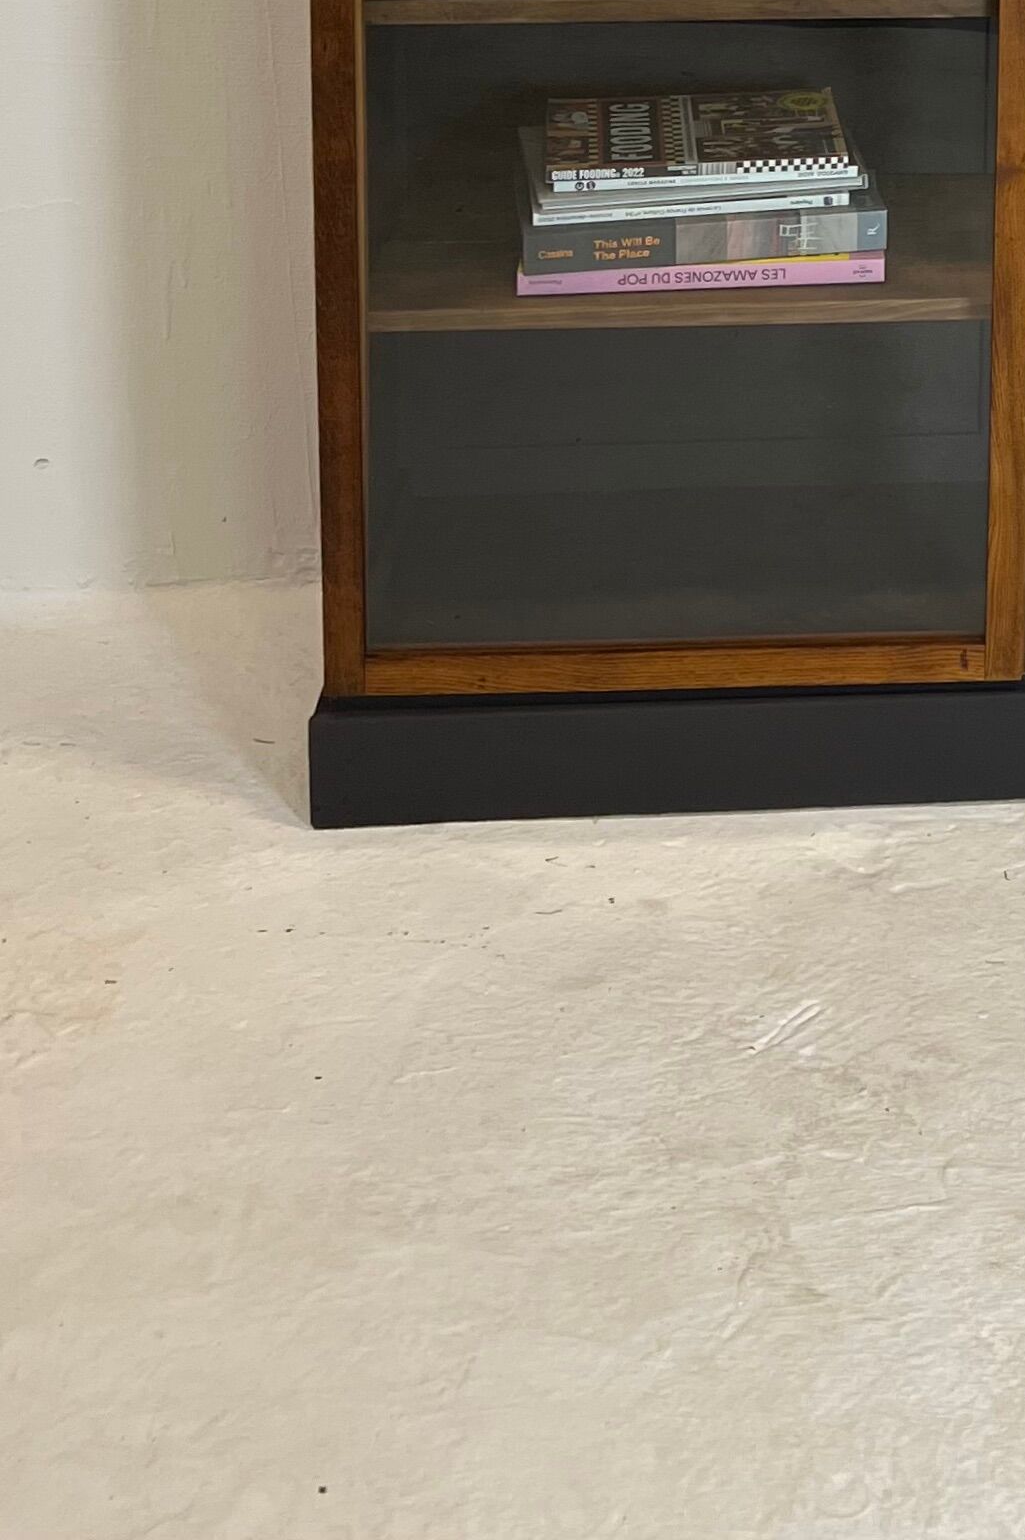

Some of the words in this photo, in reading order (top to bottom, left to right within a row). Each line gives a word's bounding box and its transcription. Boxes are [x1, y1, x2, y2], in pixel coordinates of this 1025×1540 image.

[609, 103, 654, 161] FOODING
[551, 170, 577, 181] GUIDE
[622, 167, 645, 178] 2022
[593, 239, 618, 250] This
[645, 236, 661, 246] Be
[593, 251, 616, 261] The
[618, 249, 651, 260] Place
[617, 273, 648, 286] POP
[651, 272, 671, 285] DU
[675, 270, 757, 284] AMAZONES
[760, 268, 787, 281] LES
